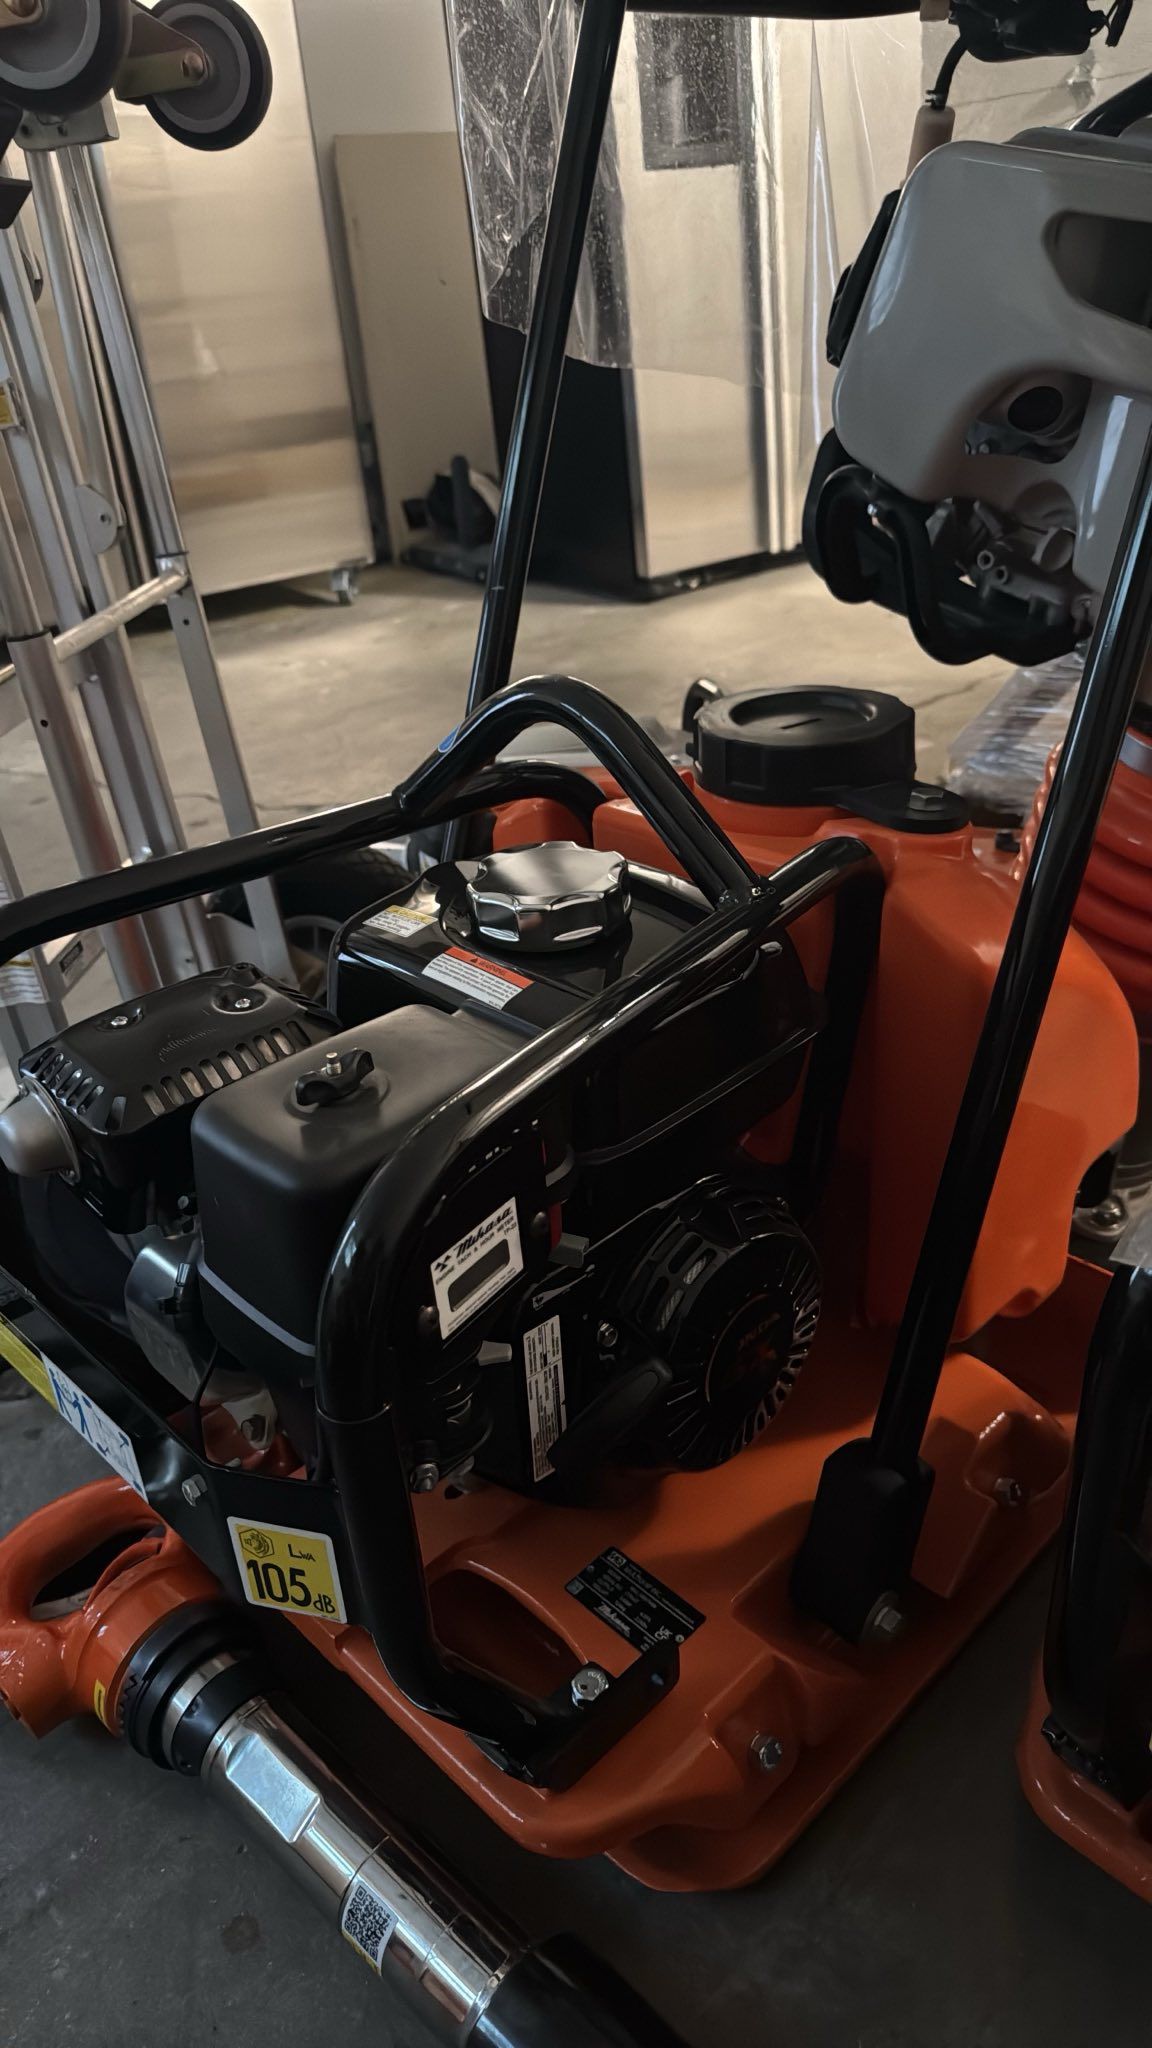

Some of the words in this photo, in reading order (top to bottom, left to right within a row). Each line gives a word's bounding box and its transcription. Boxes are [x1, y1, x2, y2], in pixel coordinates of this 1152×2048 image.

[435, 1266, 455, 1285] ENGINE
[457, 1252, 472, 1265] TACH
[480, 1232, 495, 1247] HOUR
[496, 1216, 515, 1232] METER
[453, 1206, 513, 1259] Mikasa
